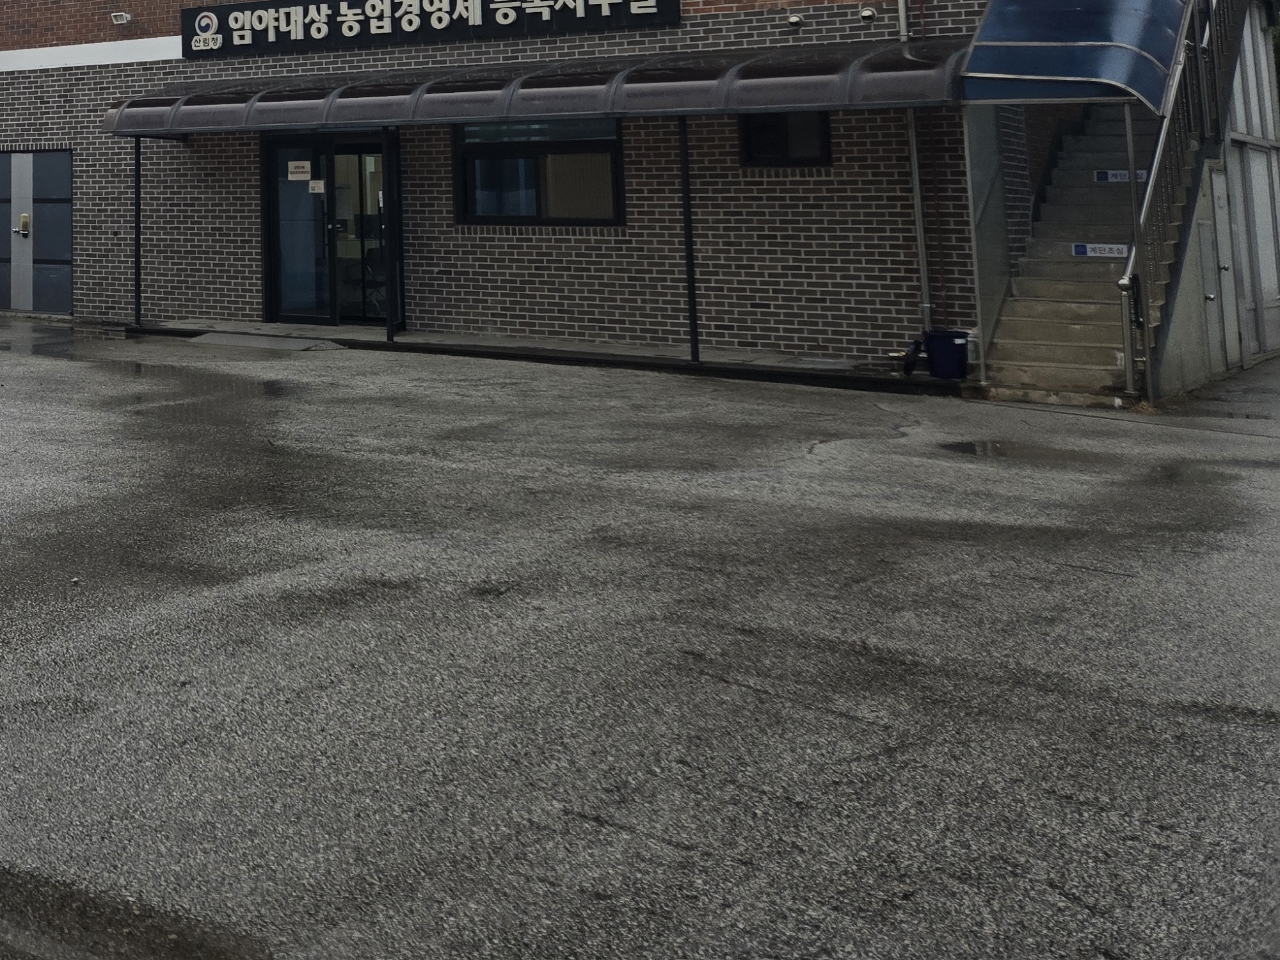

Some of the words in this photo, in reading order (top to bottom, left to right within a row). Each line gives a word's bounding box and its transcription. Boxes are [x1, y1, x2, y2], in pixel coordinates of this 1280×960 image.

[228, 3, 332, 45] 임야대상
[193, 37, 220, 48] 산림청
[1110, 172, 1144, 180] 계단심
[1089, 246, 1124, 255] 계단조심
